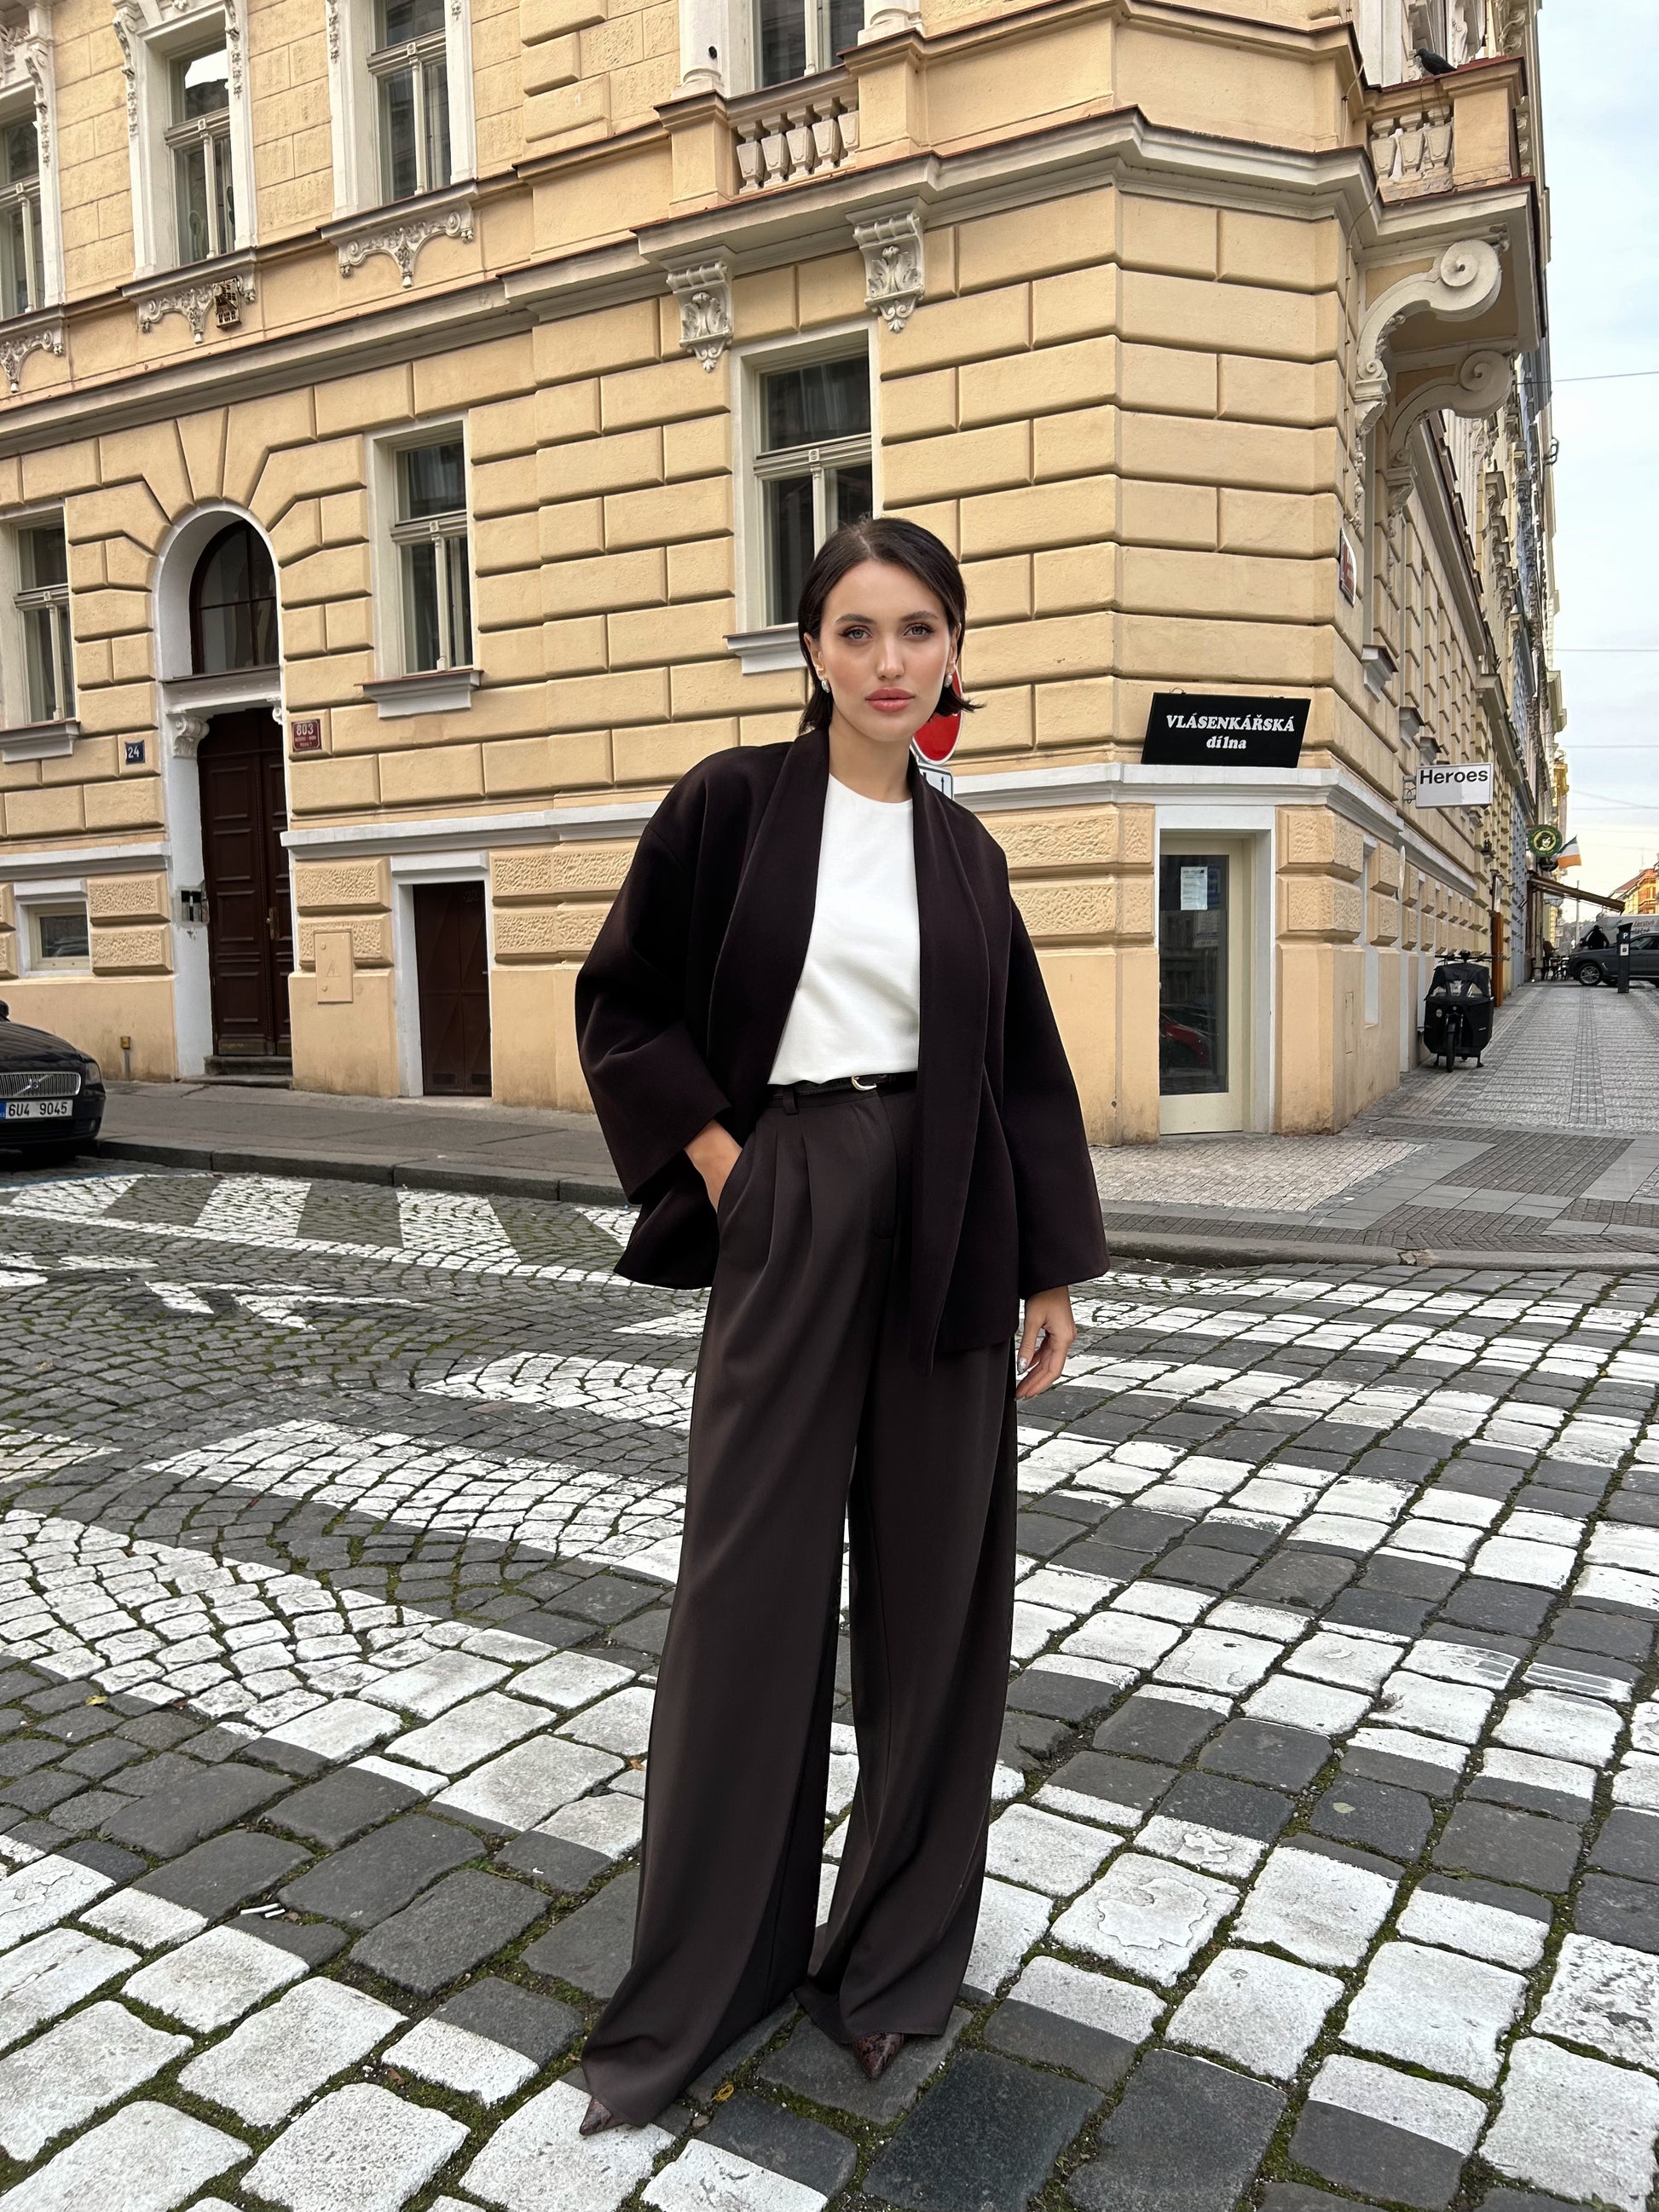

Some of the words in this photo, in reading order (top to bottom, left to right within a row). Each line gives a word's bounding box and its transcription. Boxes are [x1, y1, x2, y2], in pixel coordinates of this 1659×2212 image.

[1166, 713, 1294, 731] VLÁSENKÁŘSKÁ
[296, 724, 314, 736] 803
[1206, 736, 1246, 749] dílna
[128, 746, 140, 759] 24
[1420, 770, 1488, 784] Heroes
[9, 1103, 30, 1117] 6U4
[39, 1101, 67, 1115] 9045
